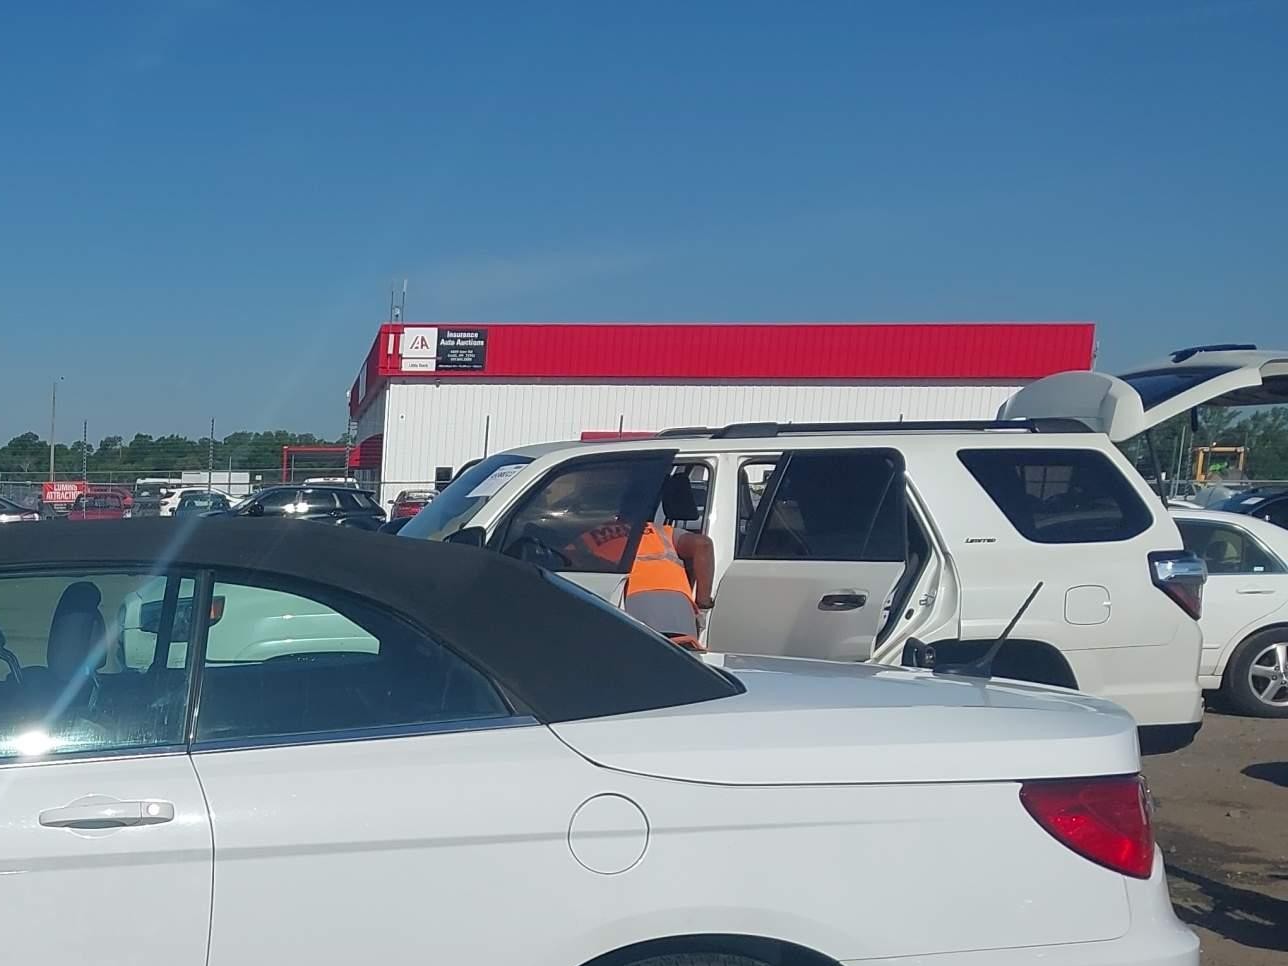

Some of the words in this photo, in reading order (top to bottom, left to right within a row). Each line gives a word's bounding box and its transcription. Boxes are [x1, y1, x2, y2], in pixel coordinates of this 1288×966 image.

[447, 330, 479, 339] Insurance
[440, 338, 455, 346] Auto
[456, 338, 484, 346] Auctions
